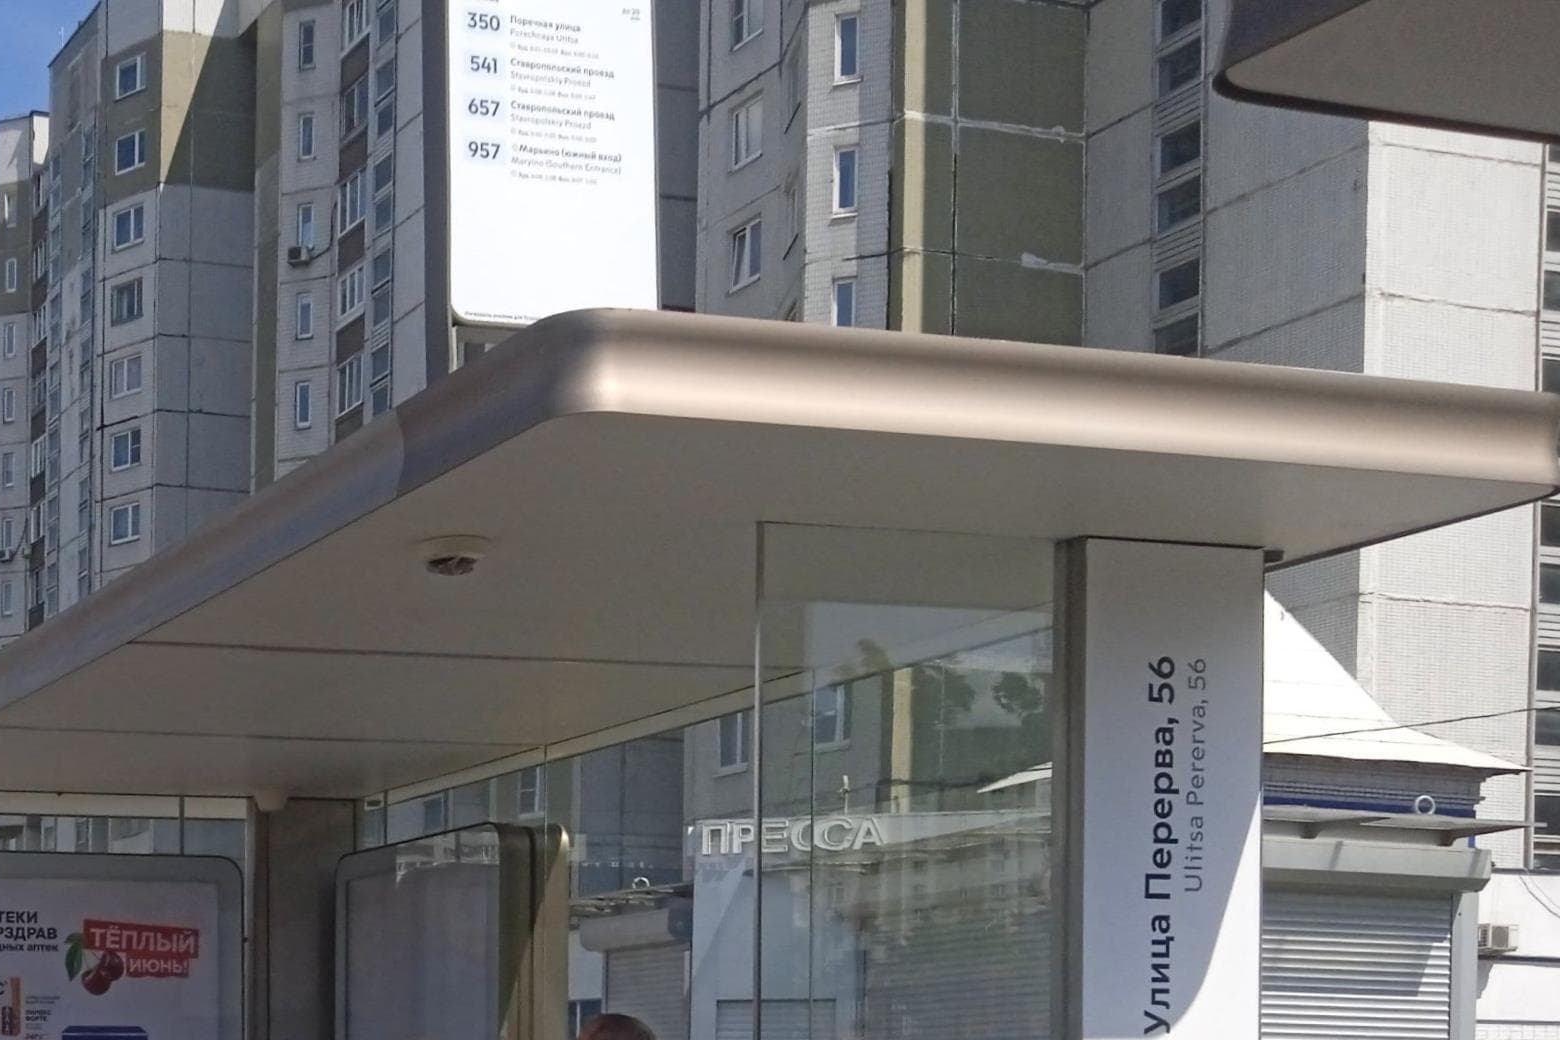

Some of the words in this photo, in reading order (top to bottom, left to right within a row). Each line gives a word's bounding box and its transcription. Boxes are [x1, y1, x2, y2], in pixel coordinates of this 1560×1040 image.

[467, 12, 501, 32] 350
[470, 55, 499, 75] 541
[468, 98, 501, 117] 657
[468, 141, 501, 160] 957
[1147, 655, 1176, 705] 56
[1187, 657, 1207, 691] 56
[1185, 699, 1209, 808] Pererva,
[1143, 716, 1180, 901] Перерва,
[701, 816, 884, 856] ПРЕССА
[1183, 813, 1204, 893] Ulitsa
[26, 943, 59, 953] аптек
[88, 924, 196, 954] ТЁПЛЫЙ
[128, 958, 189, 974] ИЮНЬ!
[1143, 912, 1175, 1036] Улица
